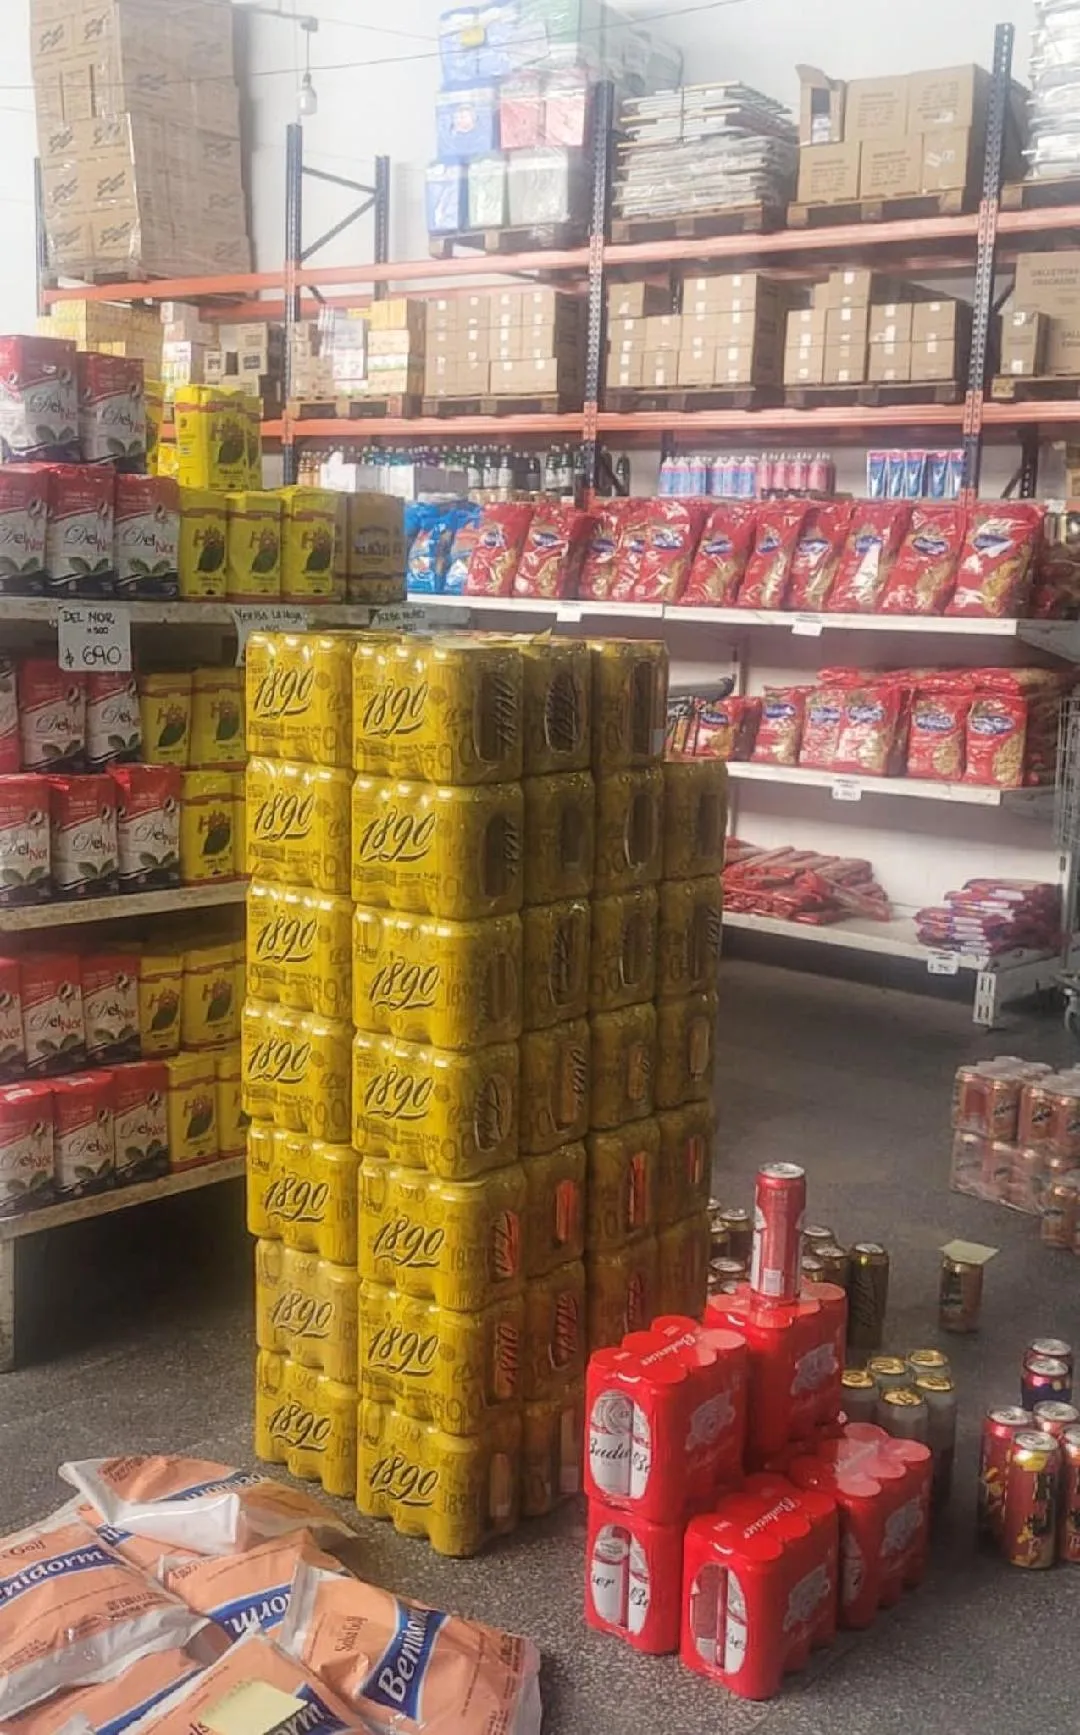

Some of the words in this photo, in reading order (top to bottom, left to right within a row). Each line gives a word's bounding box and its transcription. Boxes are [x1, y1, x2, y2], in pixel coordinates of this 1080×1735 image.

[82, 645, 122, 665] 690
[253, 662, 315, 718] 1890
[362, 678, 430, 735] 1890
[254, 788, 314, 840] 1890
[359, 807, 437, 863] 1890
[256, 914, 318, 962] 1890
[369, 956, 441, 1011] 1890
[249, 1038, 312, 1083] 1890
[364, 1063, 435, 1121] 1890
[264, 1173, 330, 1222] 1890
[373, 1213, 445, 1268] 1890
[271, 1290, 336, 1340] 1890
[369, 1324, 441, 1377] 1890
[268, 1401, 334, 1452] 1890
[369, 1454, 441, 1507] 1890
